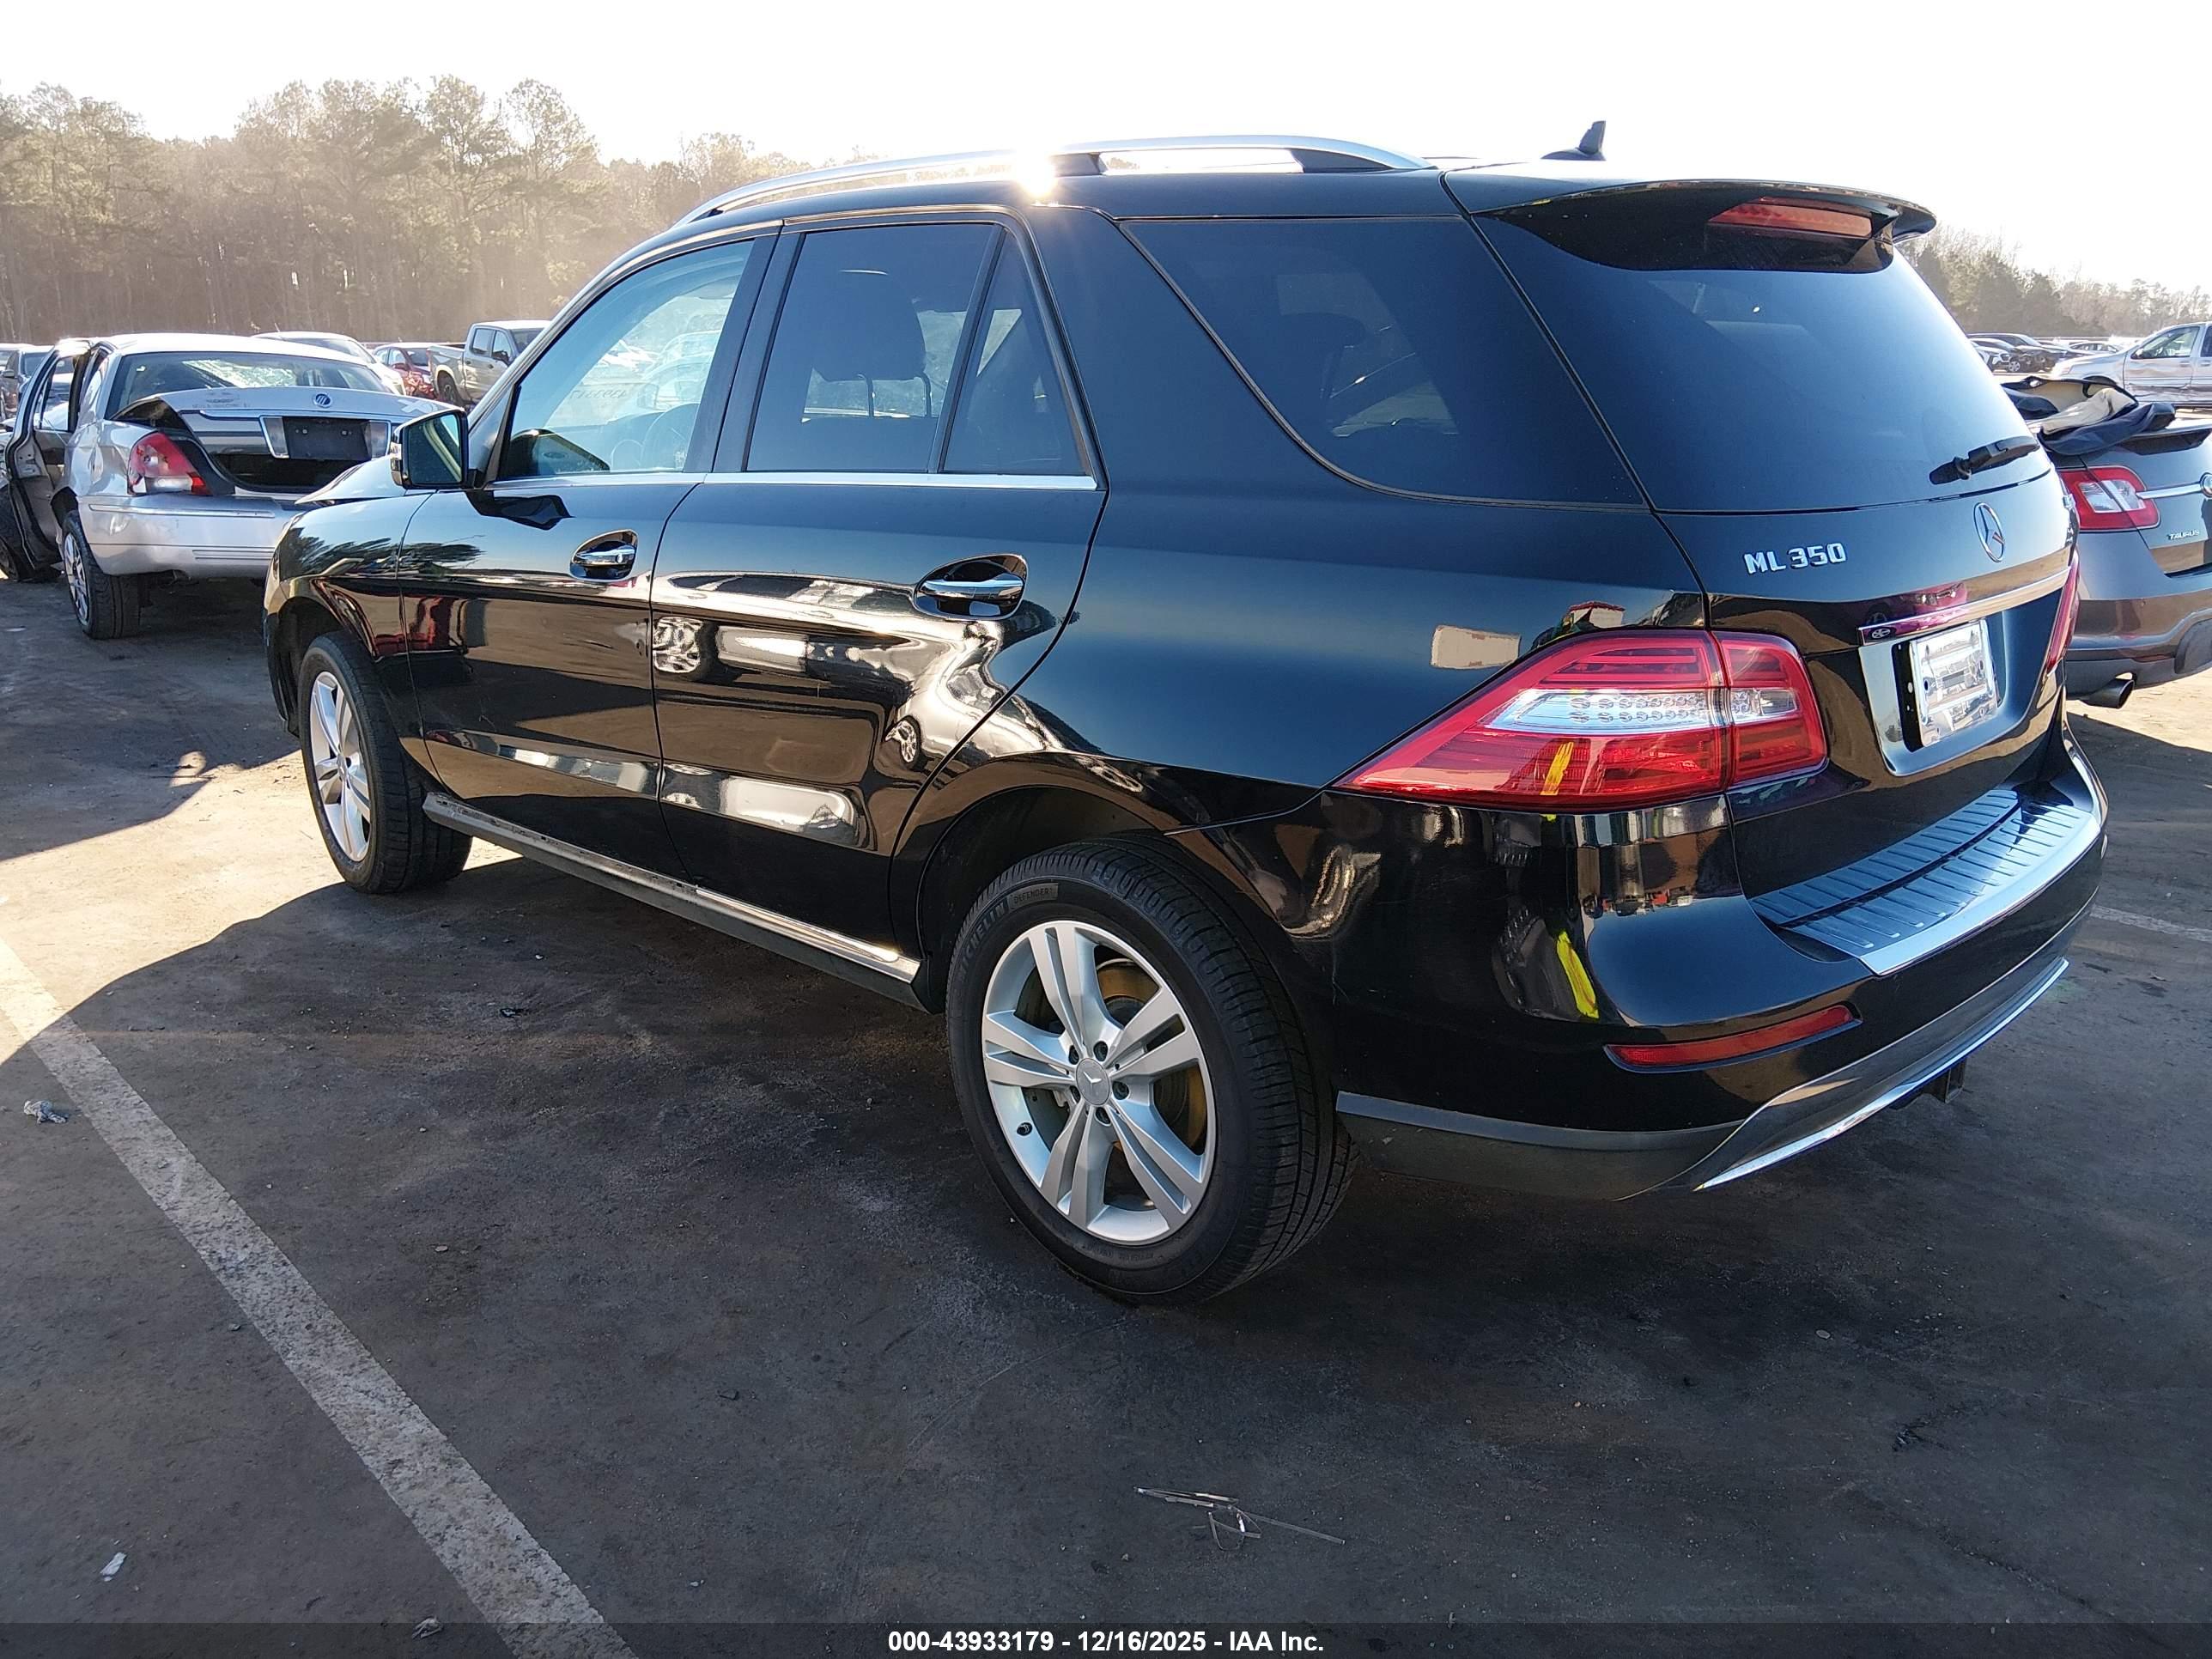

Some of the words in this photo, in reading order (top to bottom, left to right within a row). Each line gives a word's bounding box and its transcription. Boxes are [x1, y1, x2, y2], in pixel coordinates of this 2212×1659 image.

[2166, 529, 2199, 540] TAURUS
[1743, 550, 1787, 574] ML
[1787, 542, 1846, 568] 350
